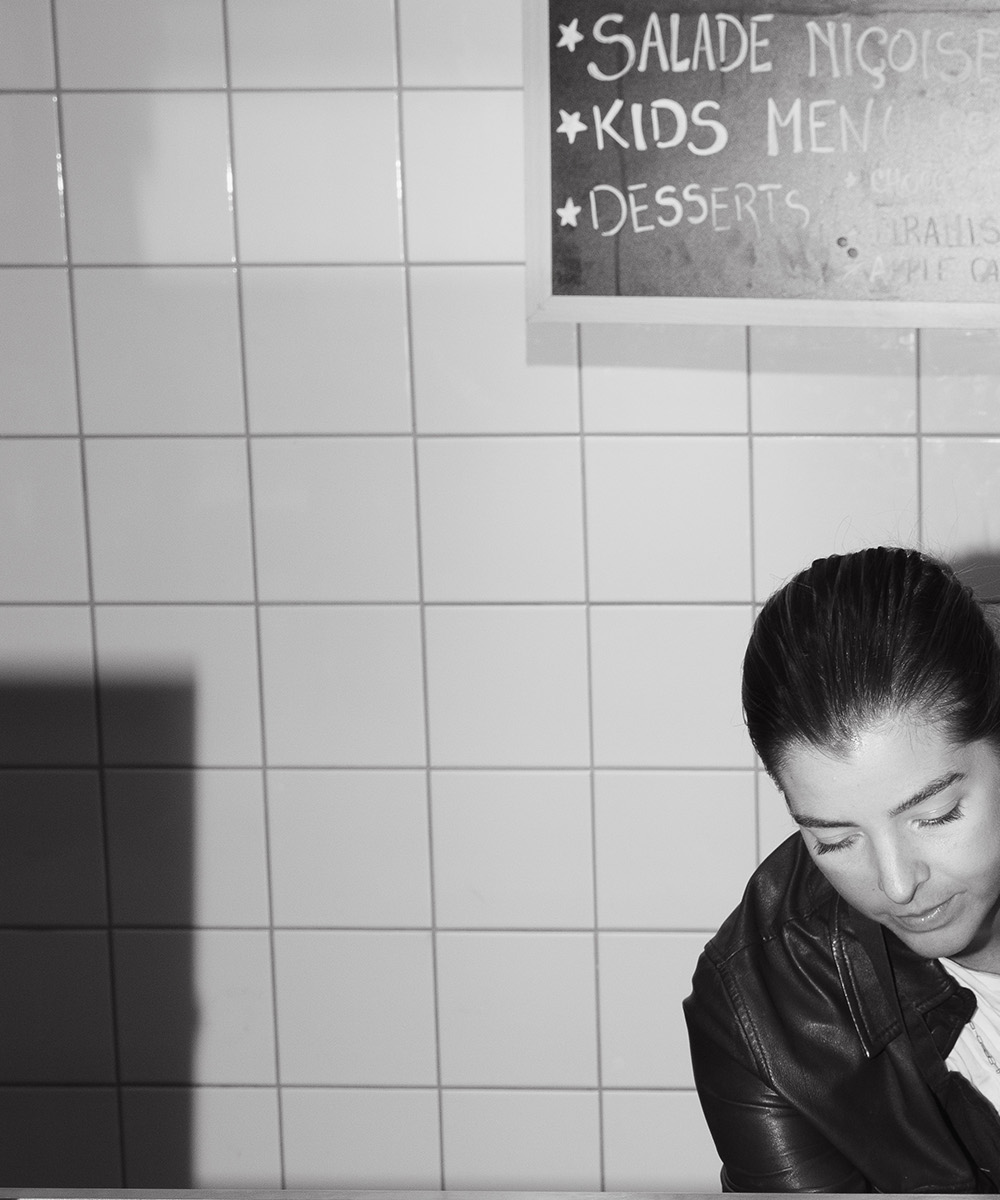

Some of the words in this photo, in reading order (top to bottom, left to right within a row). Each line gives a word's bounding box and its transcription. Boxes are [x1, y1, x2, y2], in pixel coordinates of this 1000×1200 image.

[586, 12, 775, 82] SALADE
[805, 19, 999, 88] NIÇOISE
[593, 98, 729, 156] KIDS
[589, 182, 810, 237] DESSERTS
